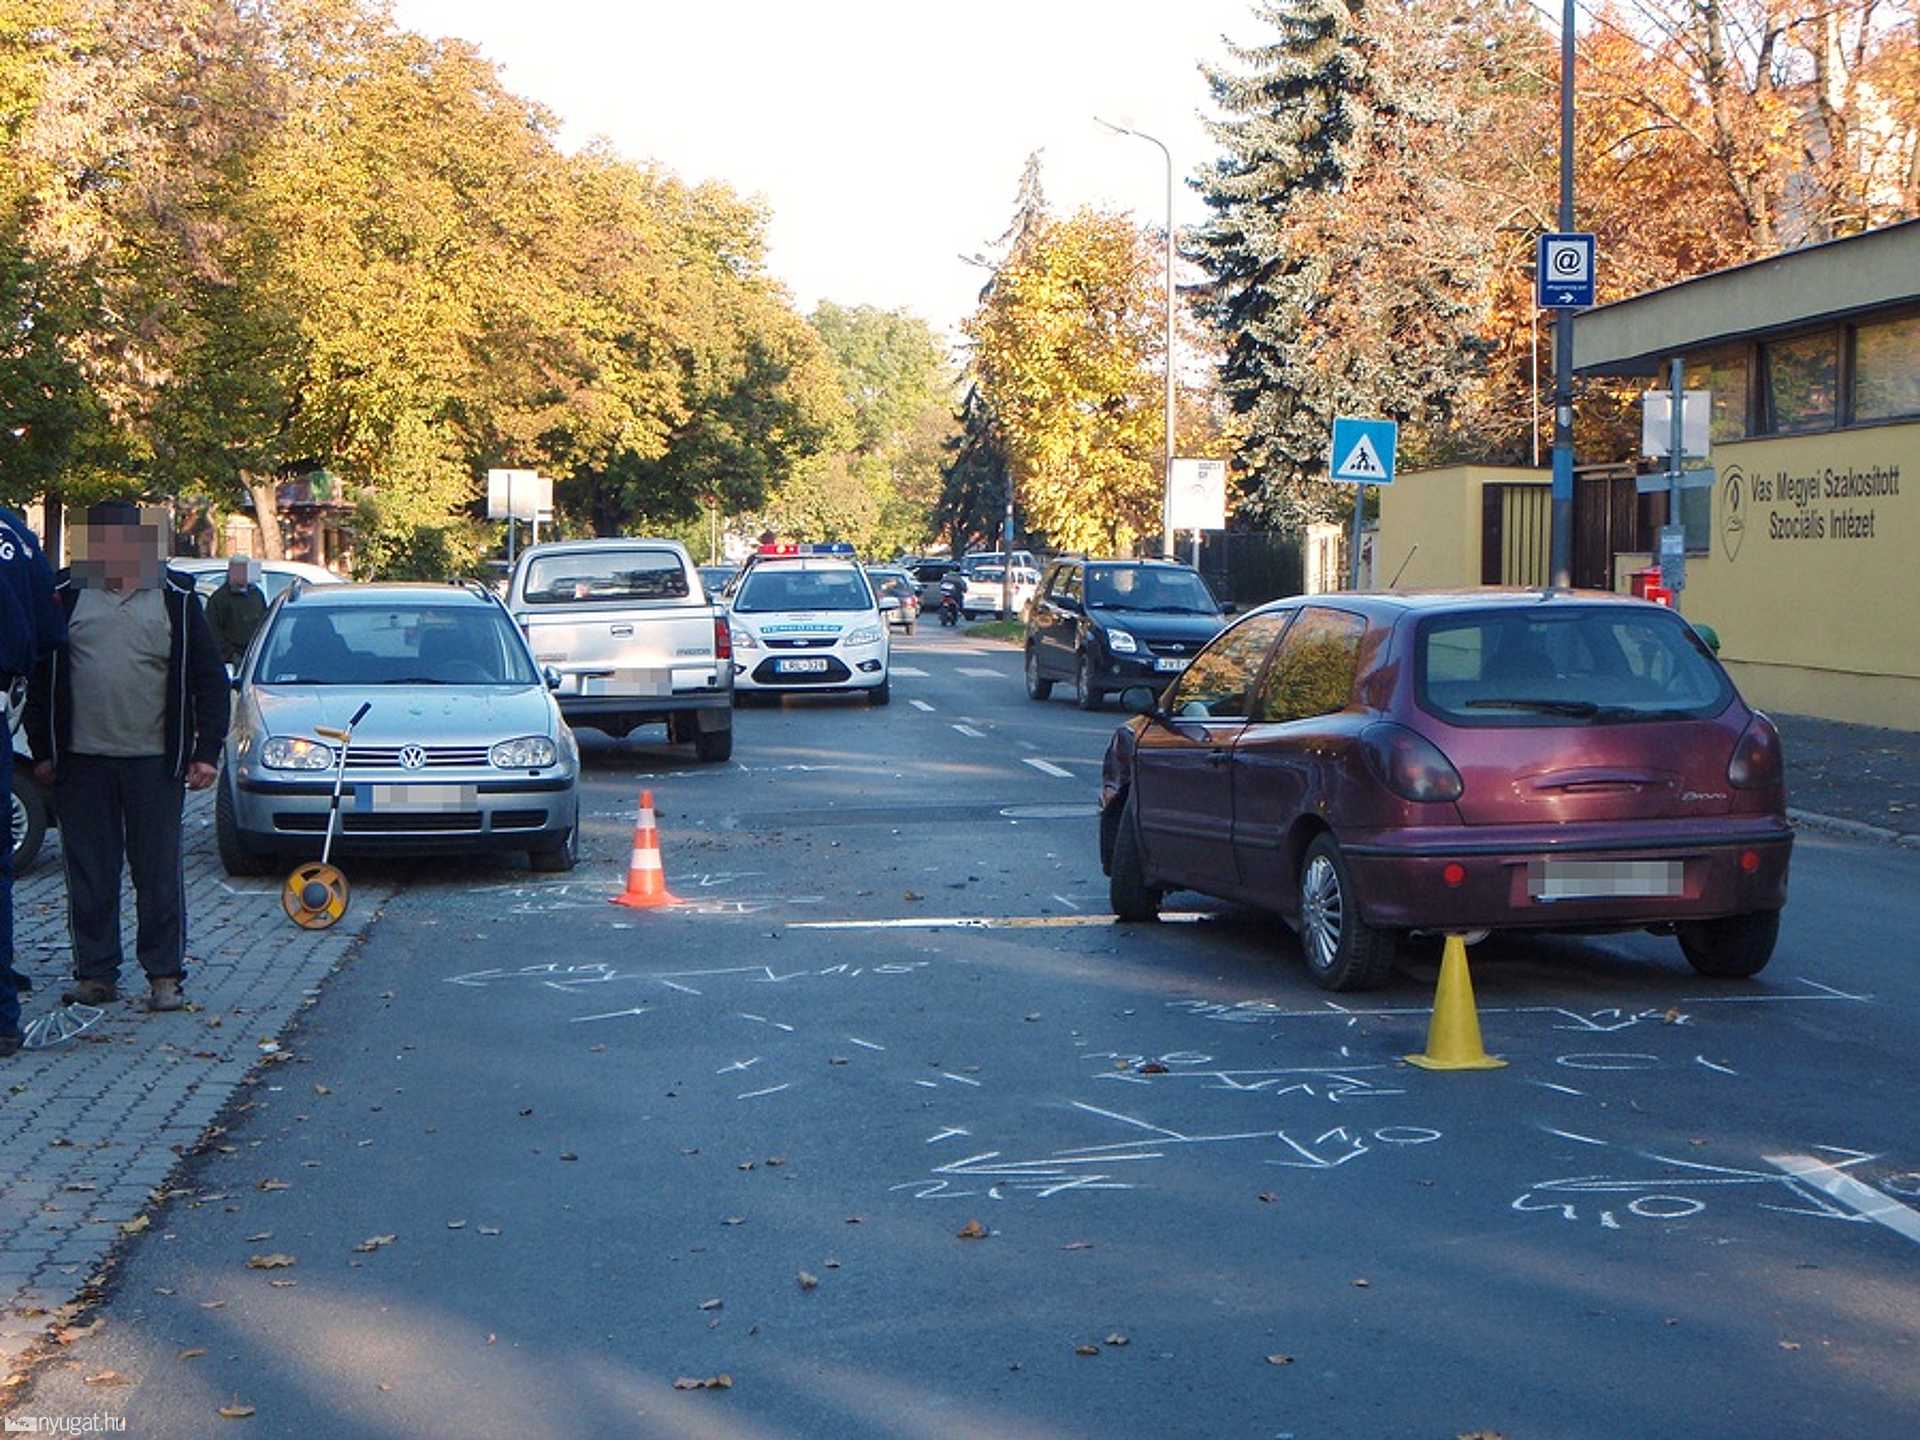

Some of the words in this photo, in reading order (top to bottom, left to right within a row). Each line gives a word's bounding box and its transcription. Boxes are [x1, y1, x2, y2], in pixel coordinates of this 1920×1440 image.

[1751, 474, 1773, 501] Vas
[1777, 471, 1820, 507] Megyei
[1824, 464, 1901, 498] Szakosított
[1769, 509, 1825, 540] Szociális
[1830, 508, 1876, 539] Intézet
